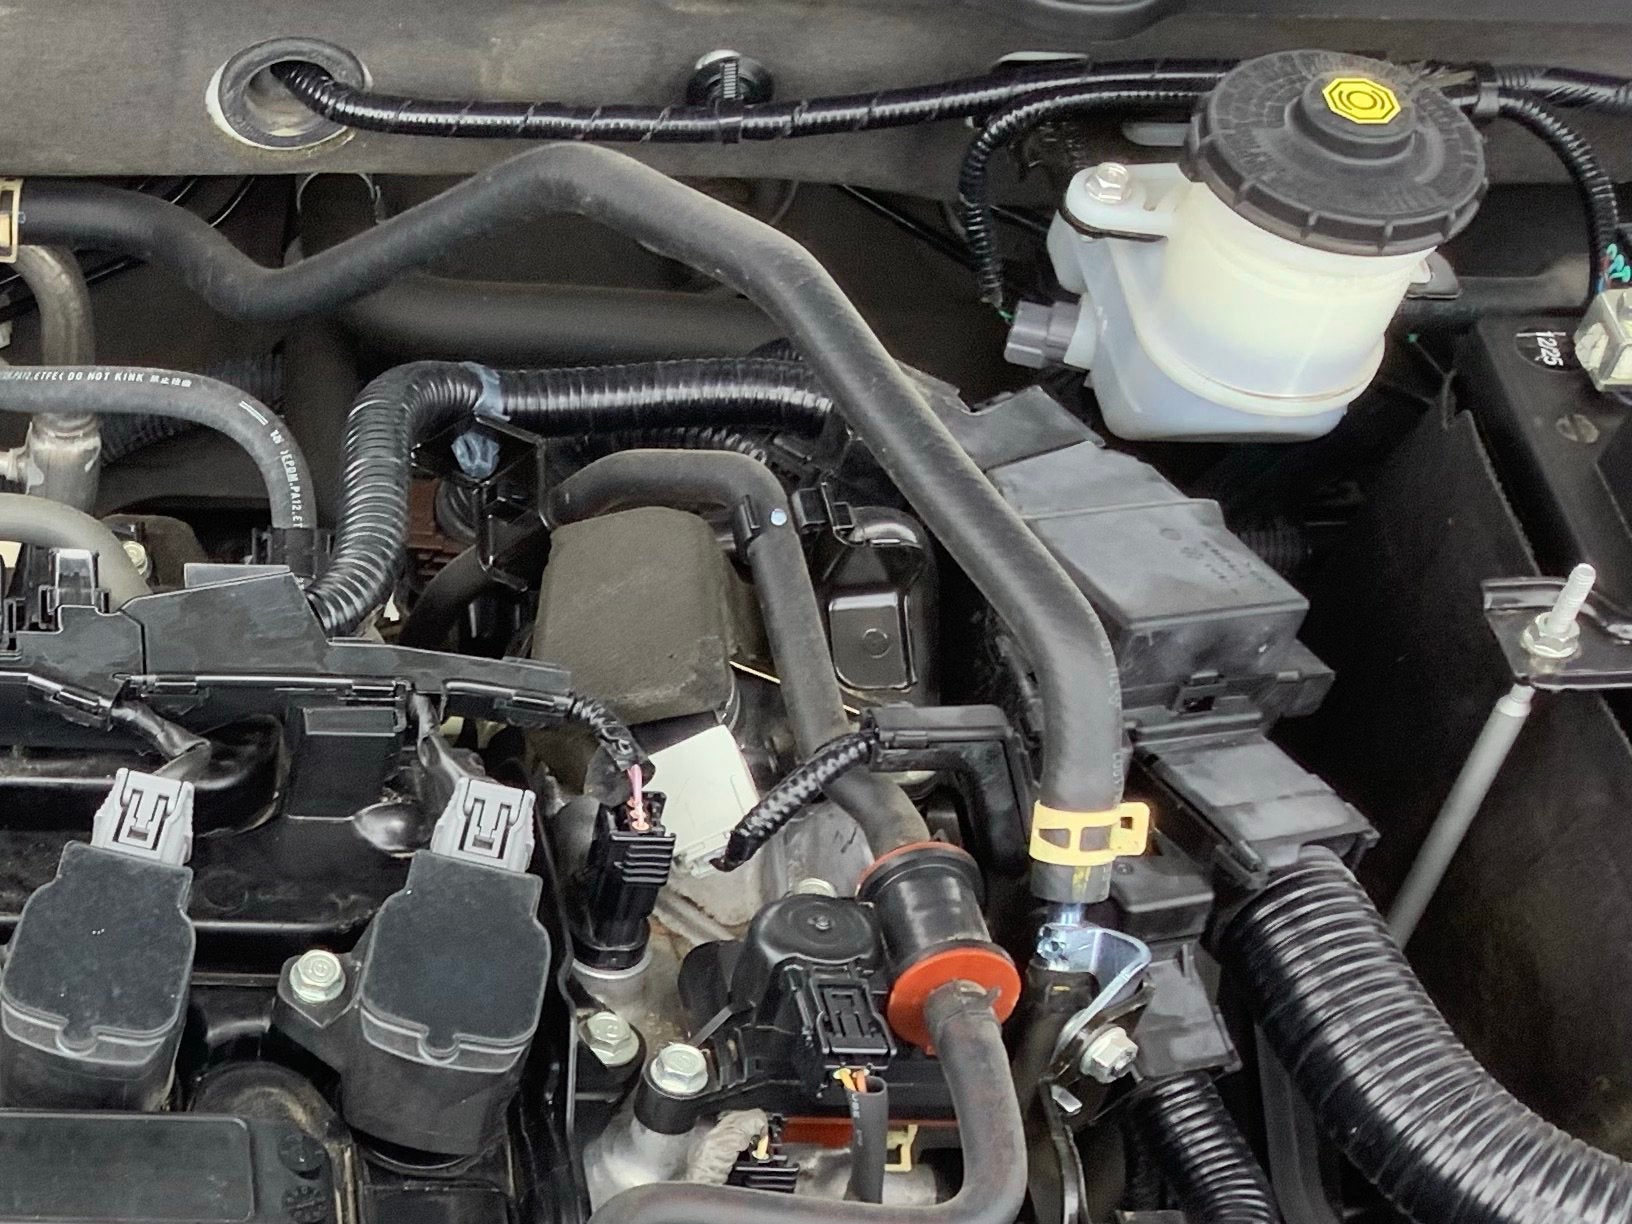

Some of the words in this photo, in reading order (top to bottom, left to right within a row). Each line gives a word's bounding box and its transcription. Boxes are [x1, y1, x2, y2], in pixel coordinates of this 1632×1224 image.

[67, 371, 83, 381] DO
[87, 371, 110, 382] NOT
[114, 371, 144, 383] KINK
